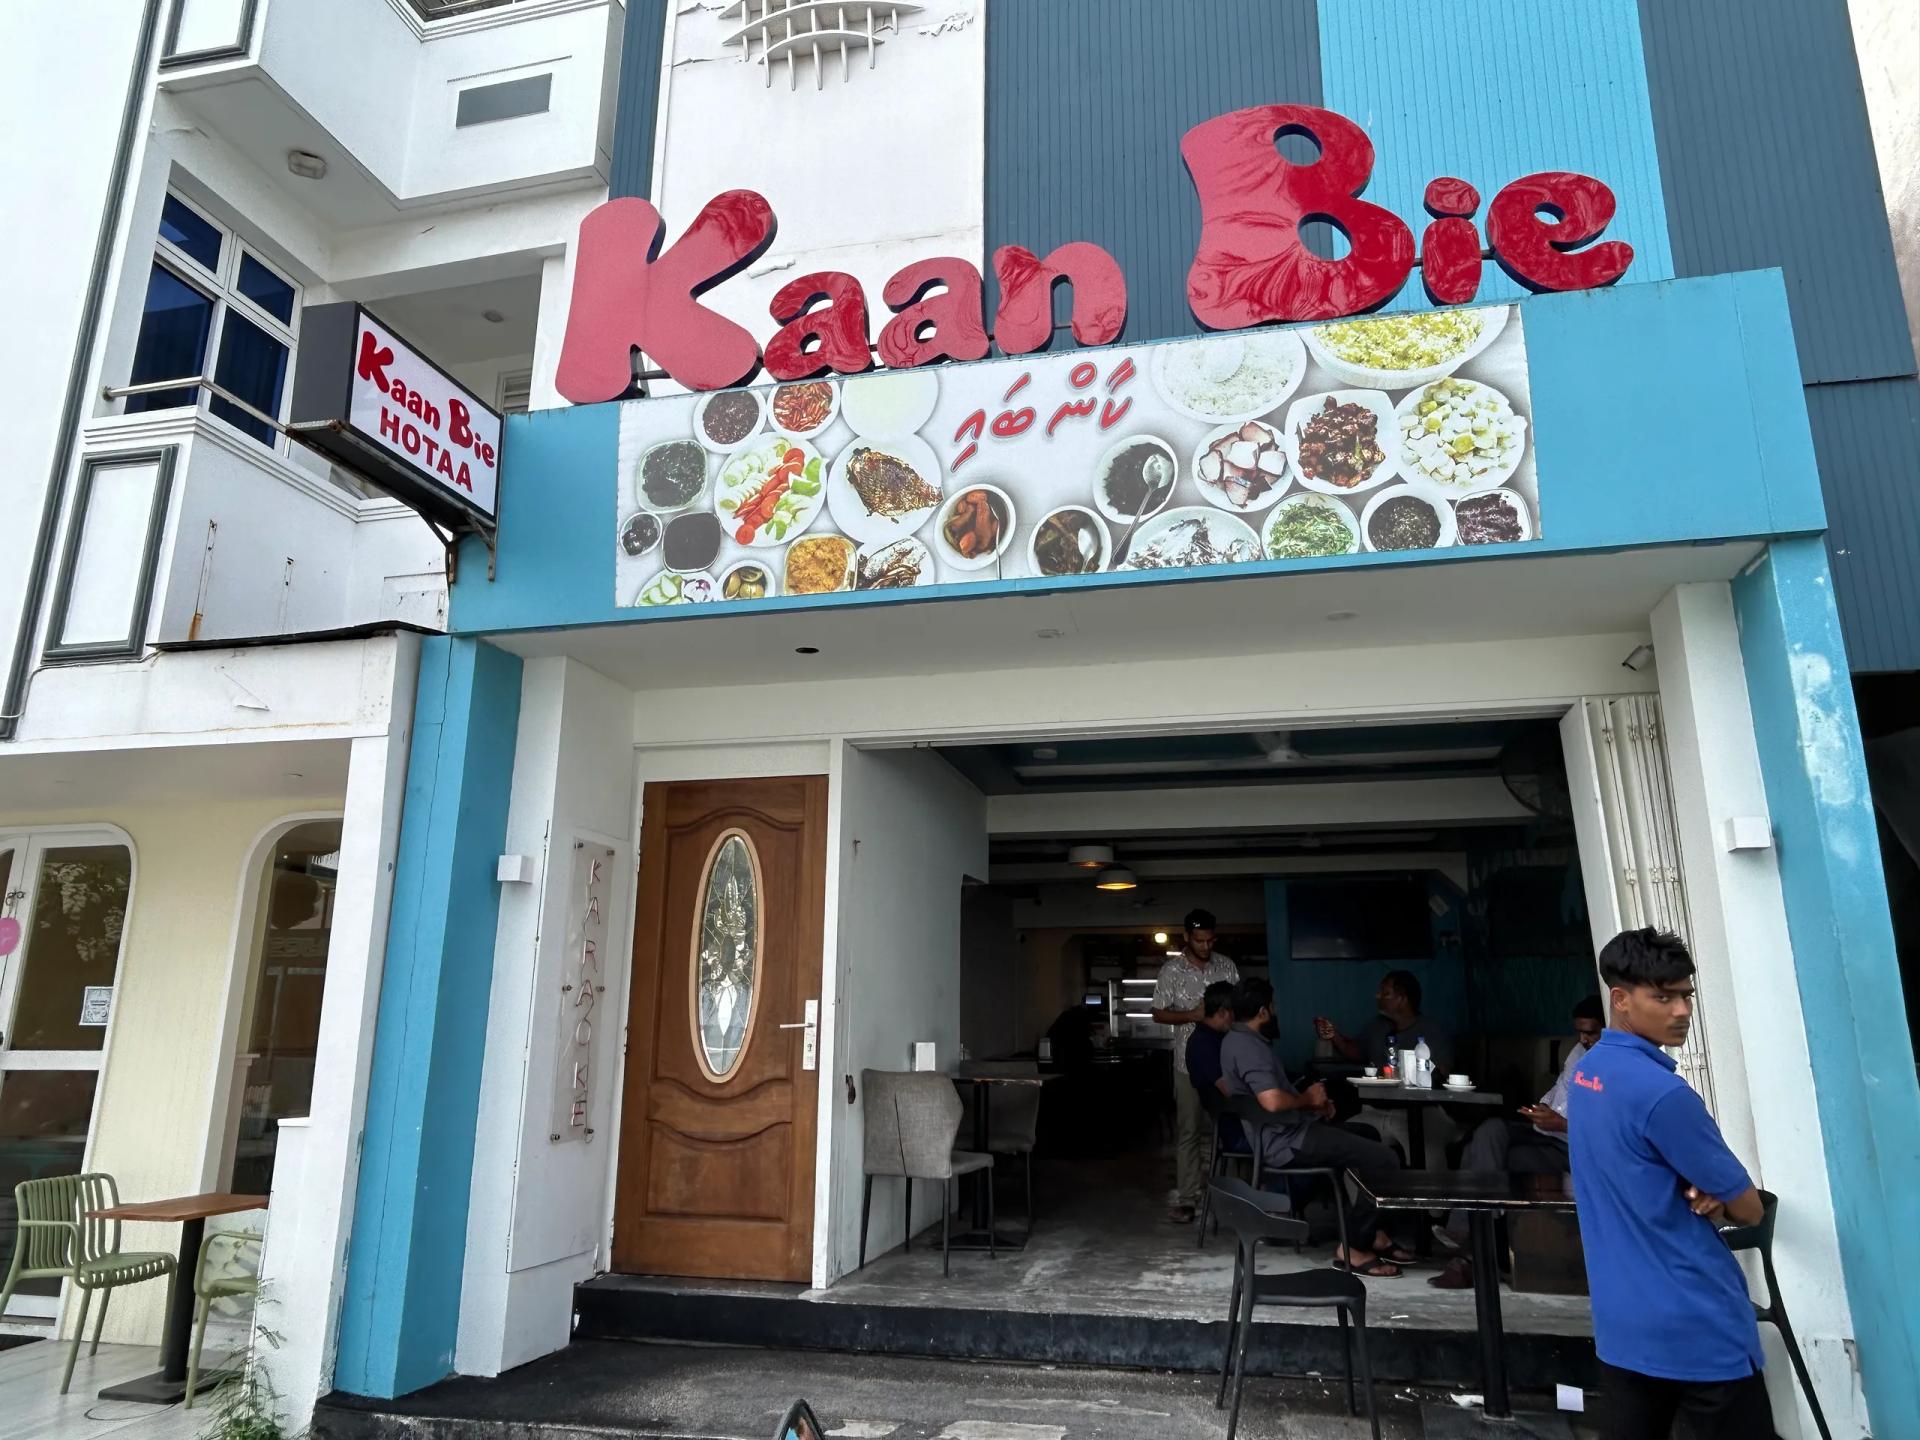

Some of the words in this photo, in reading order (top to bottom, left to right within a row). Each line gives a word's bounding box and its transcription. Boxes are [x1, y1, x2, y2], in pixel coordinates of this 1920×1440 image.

[555, 189, 1127, 403] Kaan
[1180, 104, 1634, 331] Bie
[357, 330, 441, 432] Kaan
[448, 398, 495, 468] Bie
[379, 405, 473, 493] HOTAA
[571, 858, 602, 1128] KARAOKE
